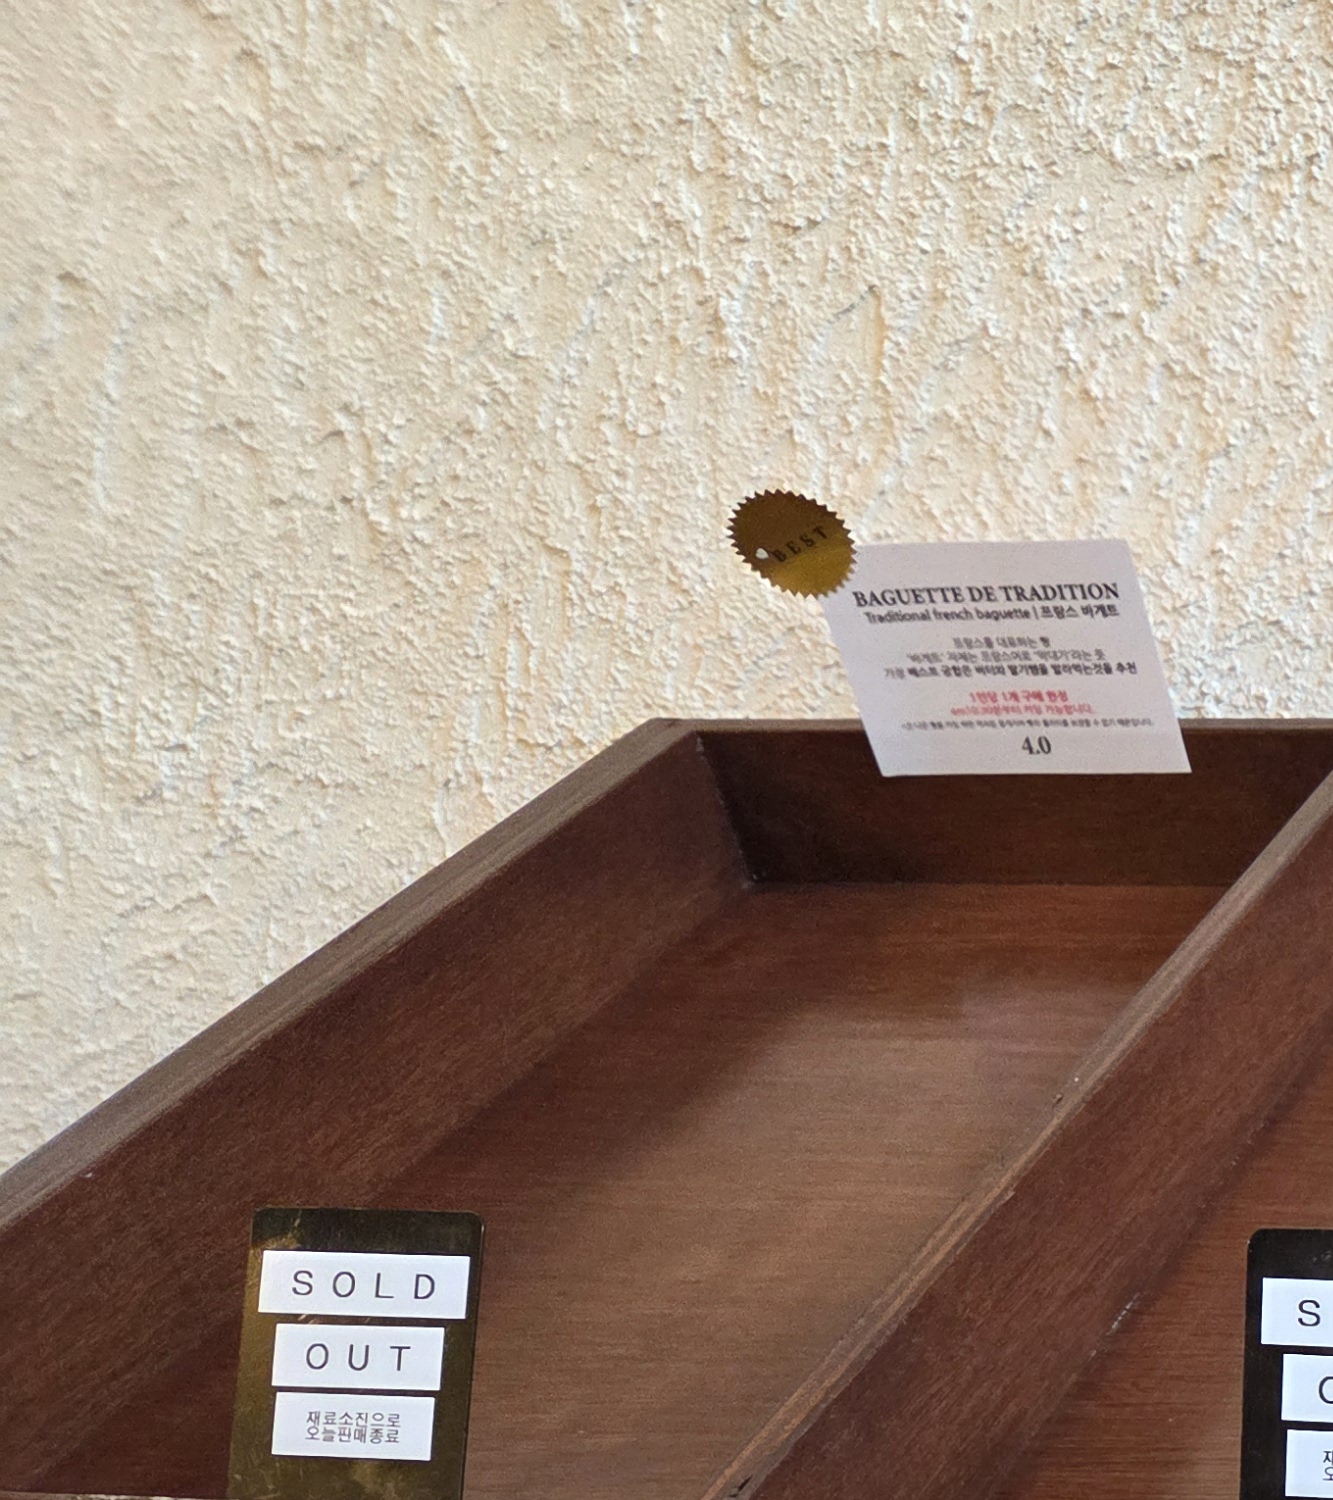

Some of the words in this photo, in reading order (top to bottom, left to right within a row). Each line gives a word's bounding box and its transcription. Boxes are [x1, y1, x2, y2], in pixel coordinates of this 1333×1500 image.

[771, 525, 829, 562] BEST
[852, 586, 965, 607] BAGUETTE
[966, 586, 997, 602] DE
[998, 582, 1119, 601] TRADITION
[863, 608, 931, 623] Traditional
[932, 607, 974, 621] french
[974, 607, 1030, 621] baguette
[1021, 736, 1051, 755] 4.0
[292, 1270, 435, 1300] SOLD
[306, 1343, 411, 1372] OUT
[306, 1411, 401, 1428] 재료소진으로
[305, 1426, 400, 1444] 오늘판매종료
